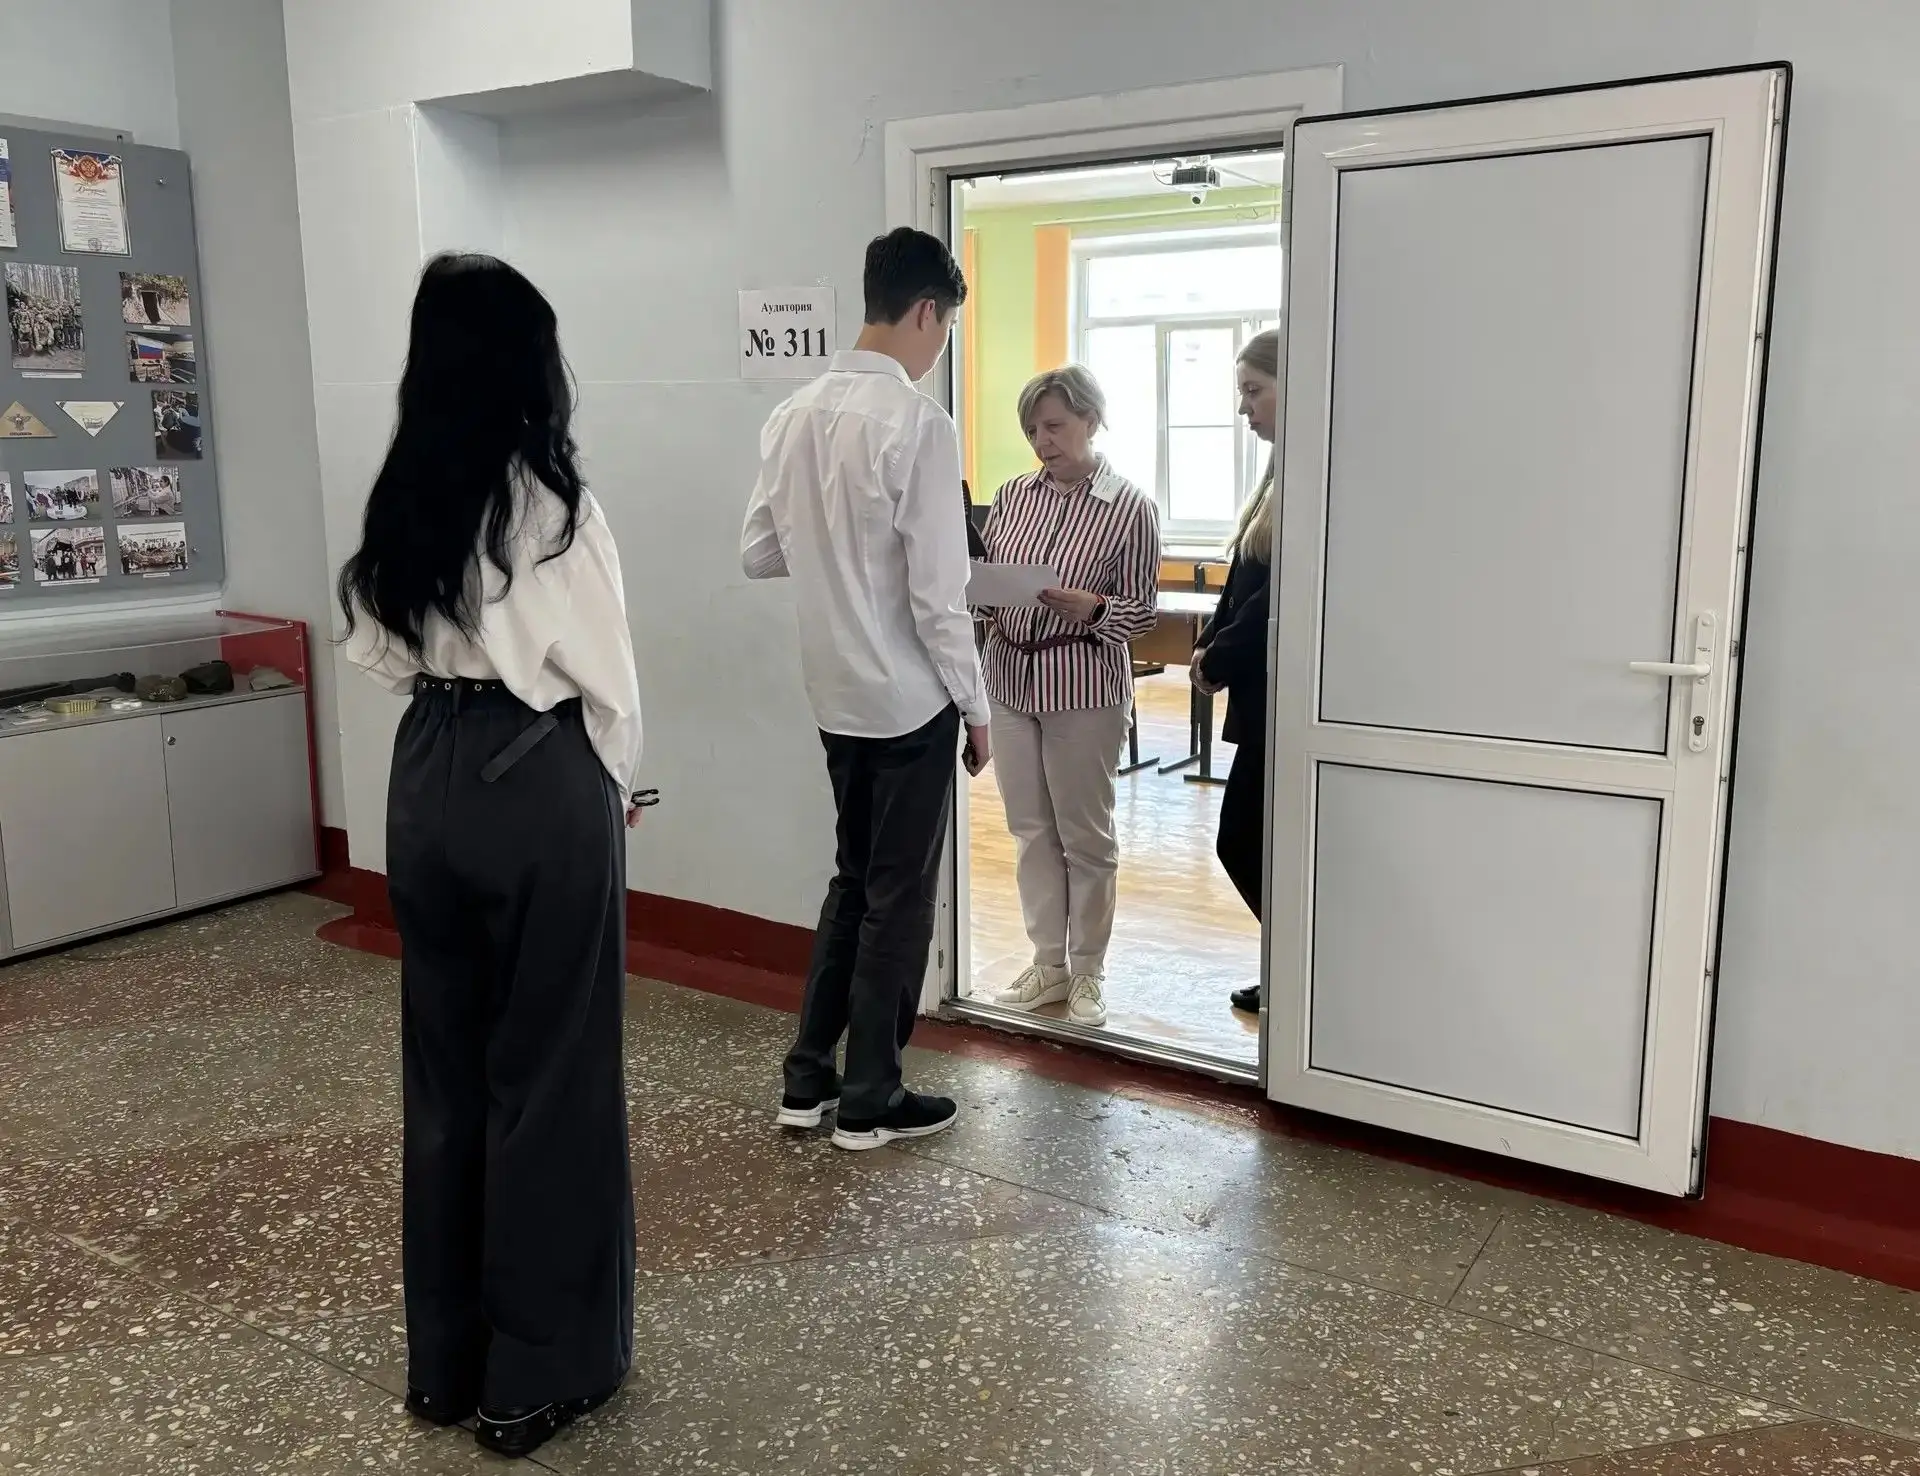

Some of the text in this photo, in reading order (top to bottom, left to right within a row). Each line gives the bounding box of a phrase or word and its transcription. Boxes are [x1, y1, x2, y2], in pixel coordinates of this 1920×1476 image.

[761, 302, 812, 315] Аудитория
[745, 327, 828, 357] № 311
